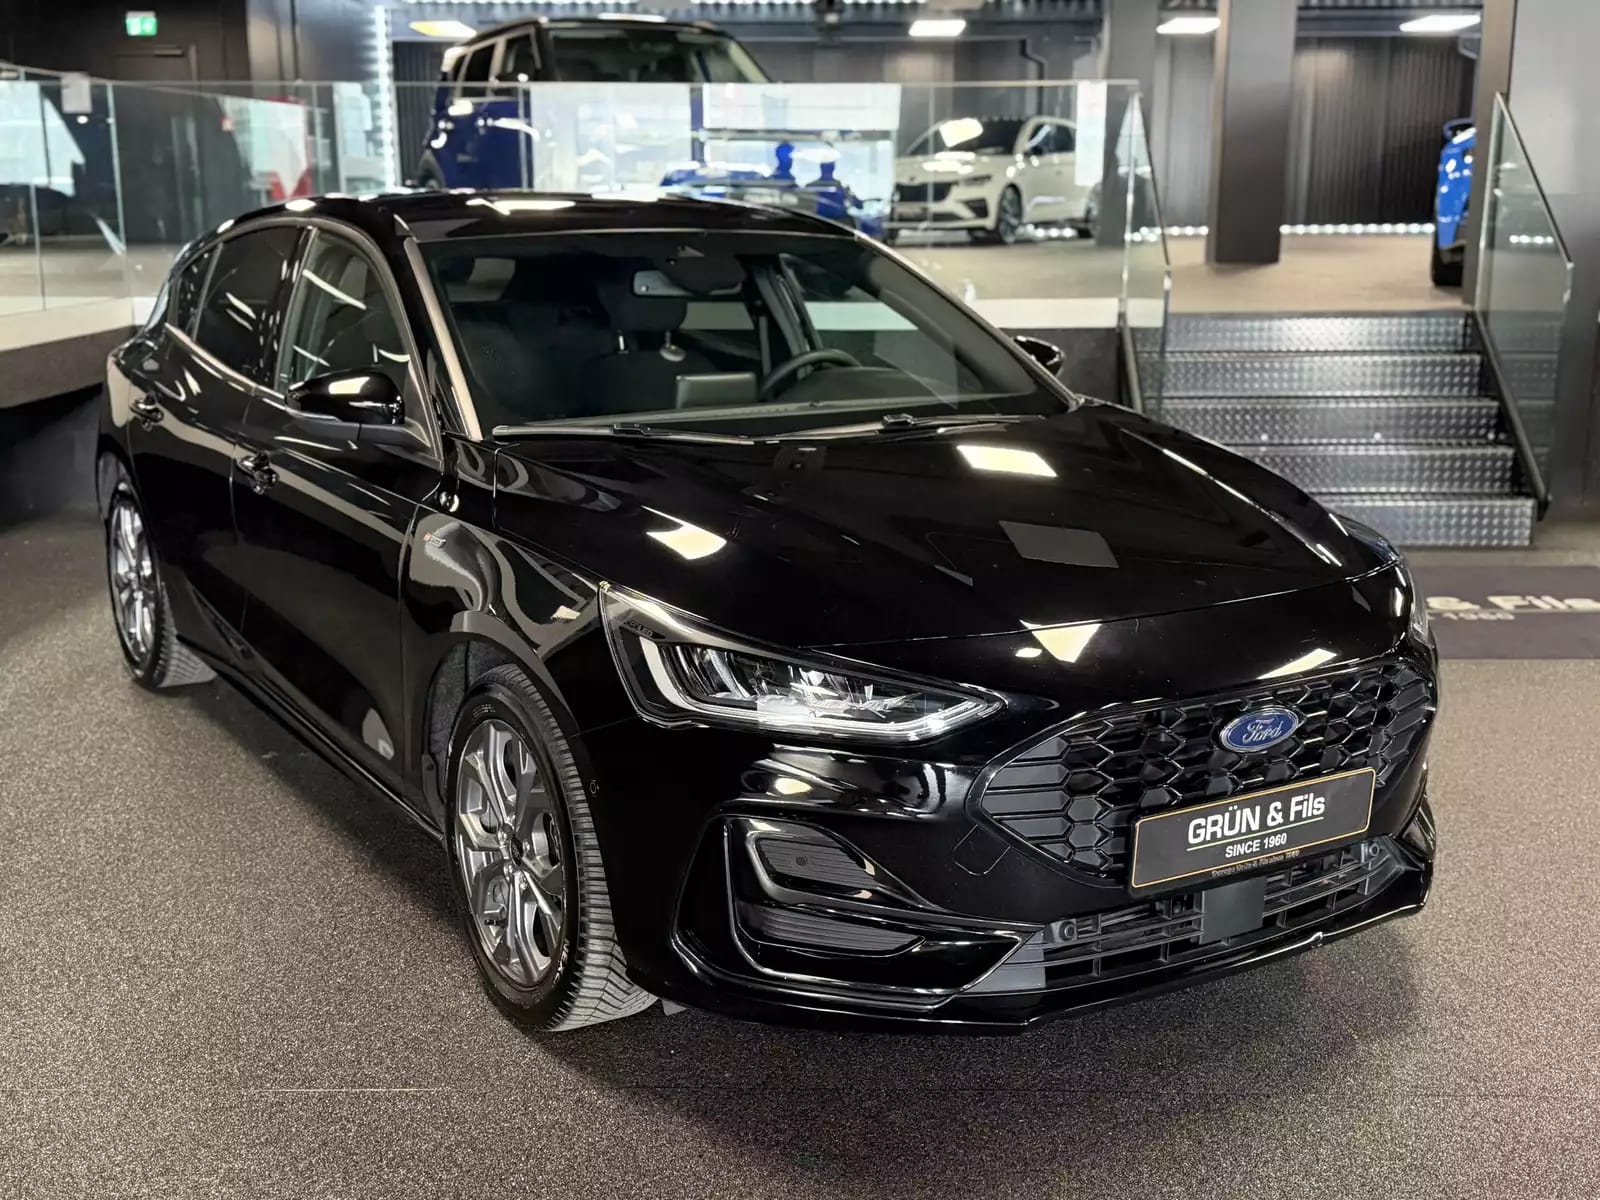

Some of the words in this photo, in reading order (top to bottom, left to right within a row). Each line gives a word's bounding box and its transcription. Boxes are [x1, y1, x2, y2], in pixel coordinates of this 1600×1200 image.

[1242, 718, 1283, 744] Ford
[1187, 805, 1261, 844] GRÜN
[1266, 801, 1285, 827] &
[1289, 793, 1325, 821] Fils
[1225, 840, 1260, 857] SINCE
[1263, 833, 1287, 849] 1960
